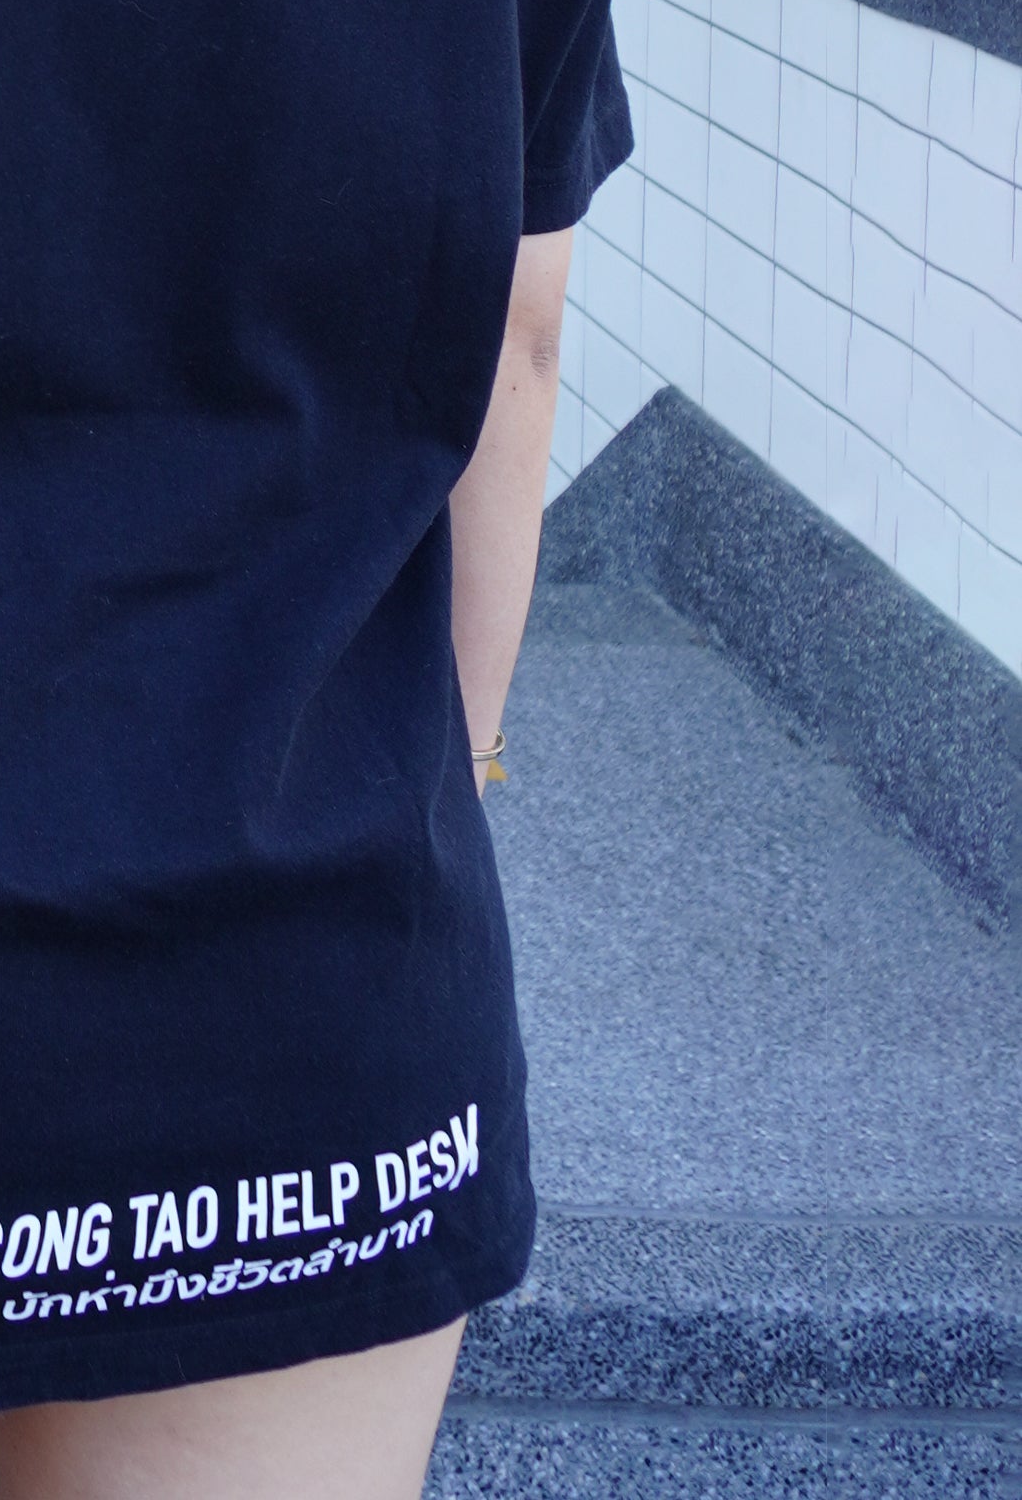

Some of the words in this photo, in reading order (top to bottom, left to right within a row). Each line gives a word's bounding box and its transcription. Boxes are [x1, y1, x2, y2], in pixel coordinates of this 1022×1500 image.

[129, 1186, 219, 1260] TAO
[236, 1161, 360, 1243] HELP
[375, 1103, 479, 1213] DESK
